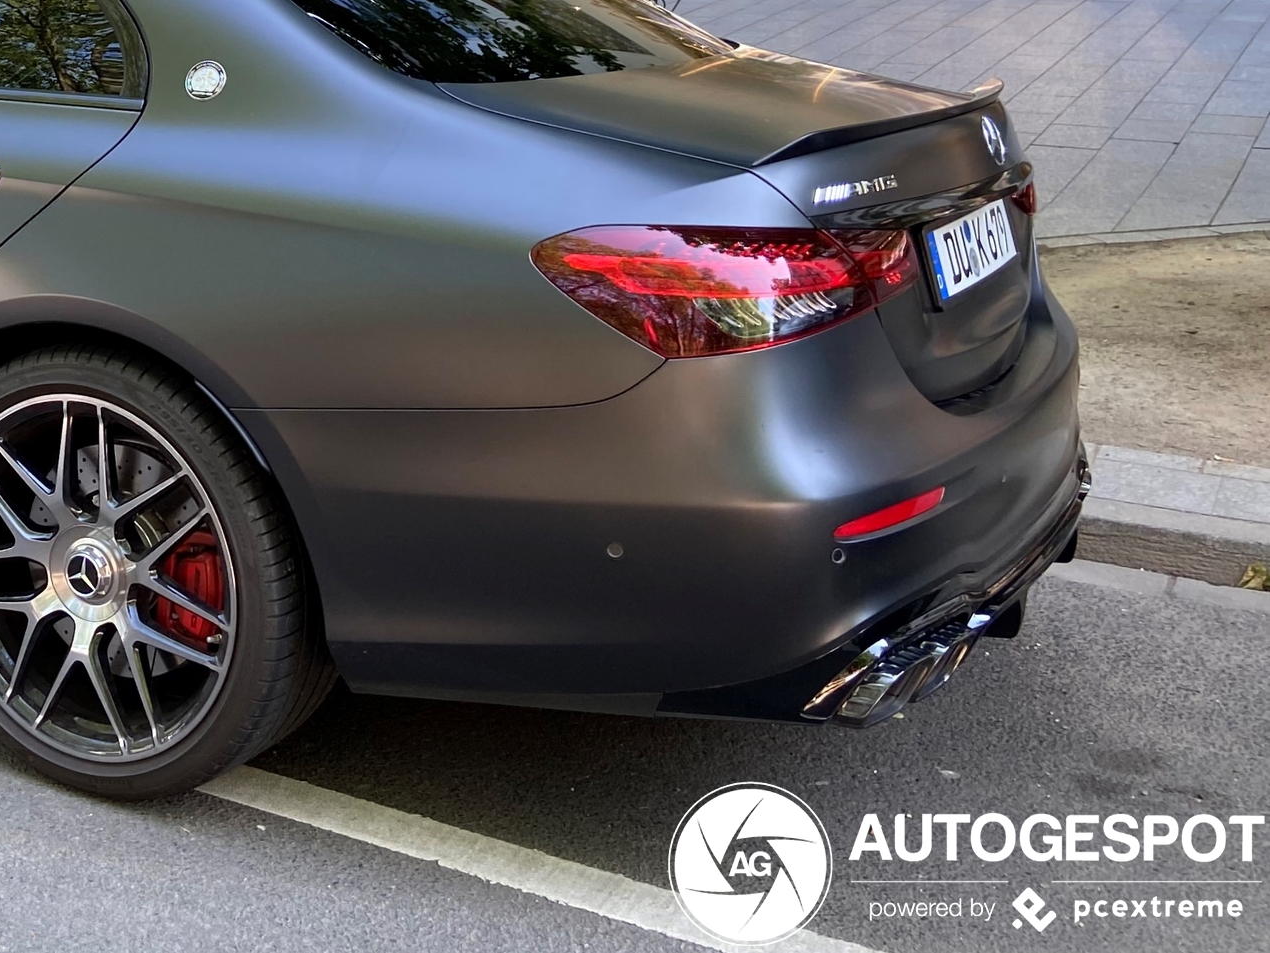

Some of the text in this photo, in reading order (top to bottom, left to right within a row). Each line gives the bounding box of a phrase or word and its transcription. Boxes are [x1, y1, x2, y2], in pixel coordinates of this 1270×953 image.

[943, 205, 1010, 284] DU K 679
